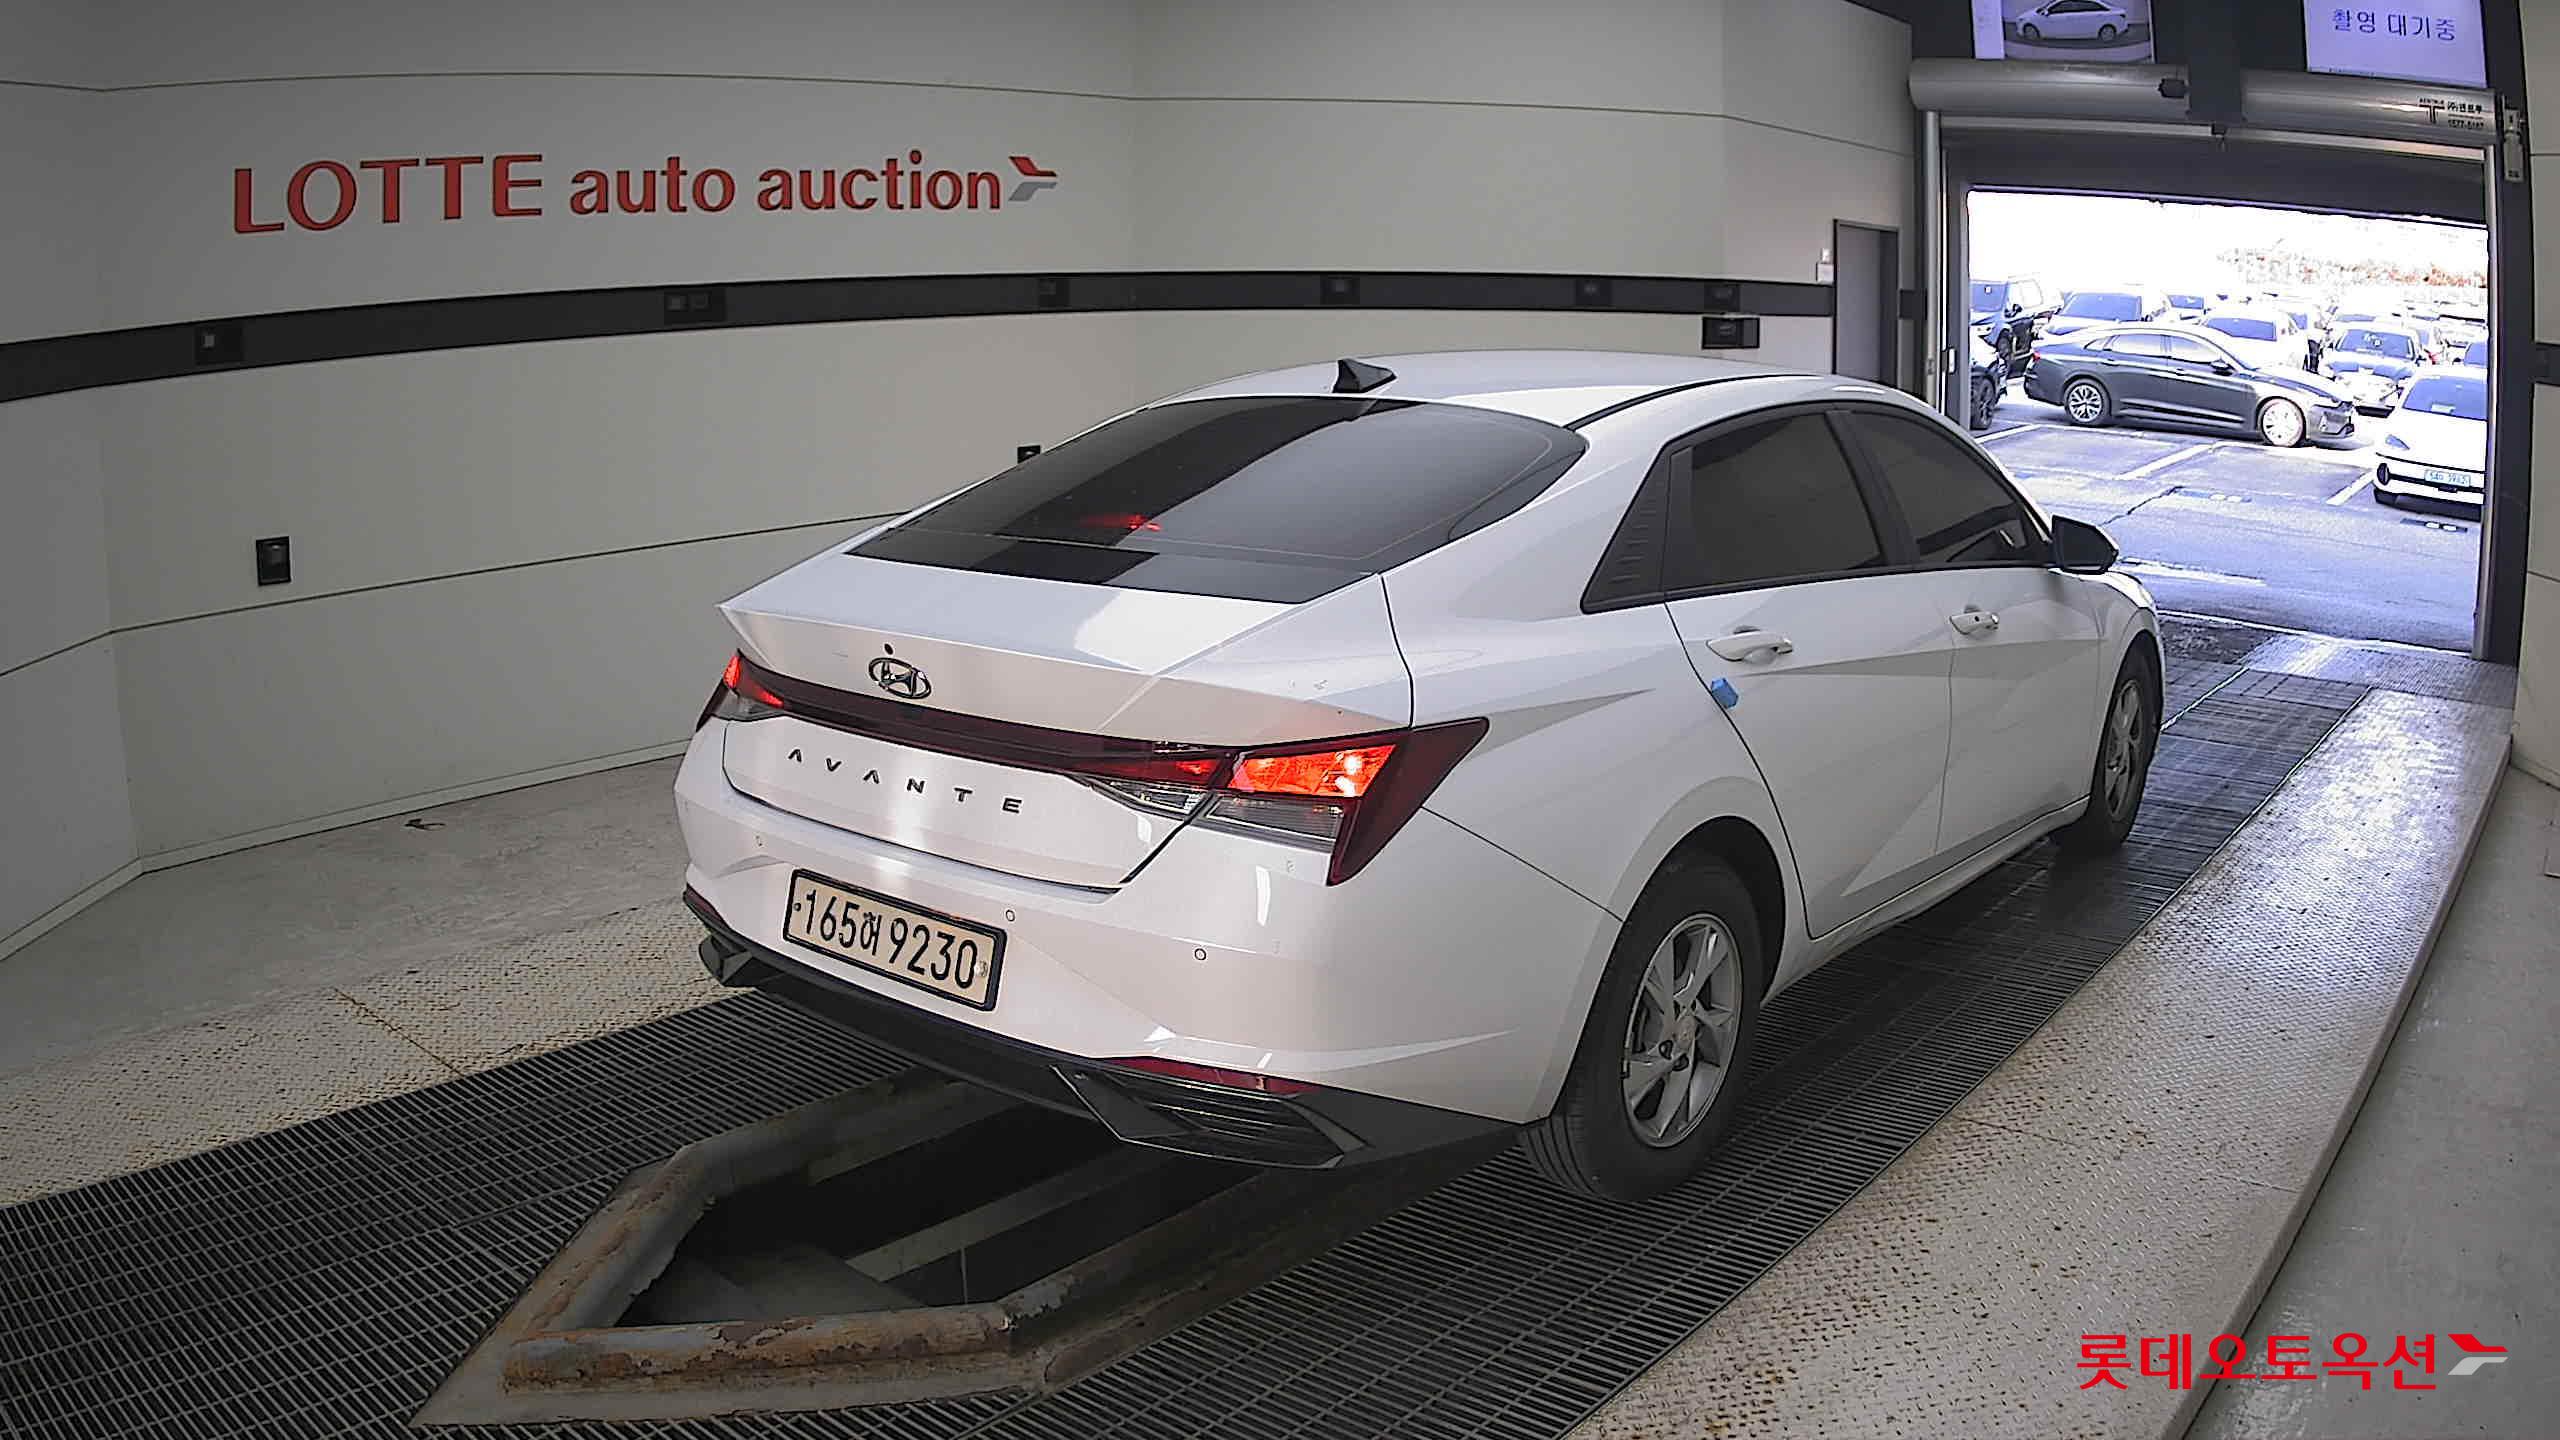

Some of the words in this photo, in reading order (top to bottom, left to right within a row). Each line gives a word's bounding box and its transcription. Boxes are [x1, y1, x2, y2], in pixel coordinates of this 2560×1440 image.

[2332, 8, 2376, 34] 촬영
[2387, 13, 2456, 42] 대기중
[233, 153, 543, 235] LOTTE
[569, 155, 736, 216] auto
[756, 149, 1001, 212] auction
[787, 748, 1023, 815] AVANTE
[805, 888, 882, 957] 165허
[888, 916, 978, 990] 9230
